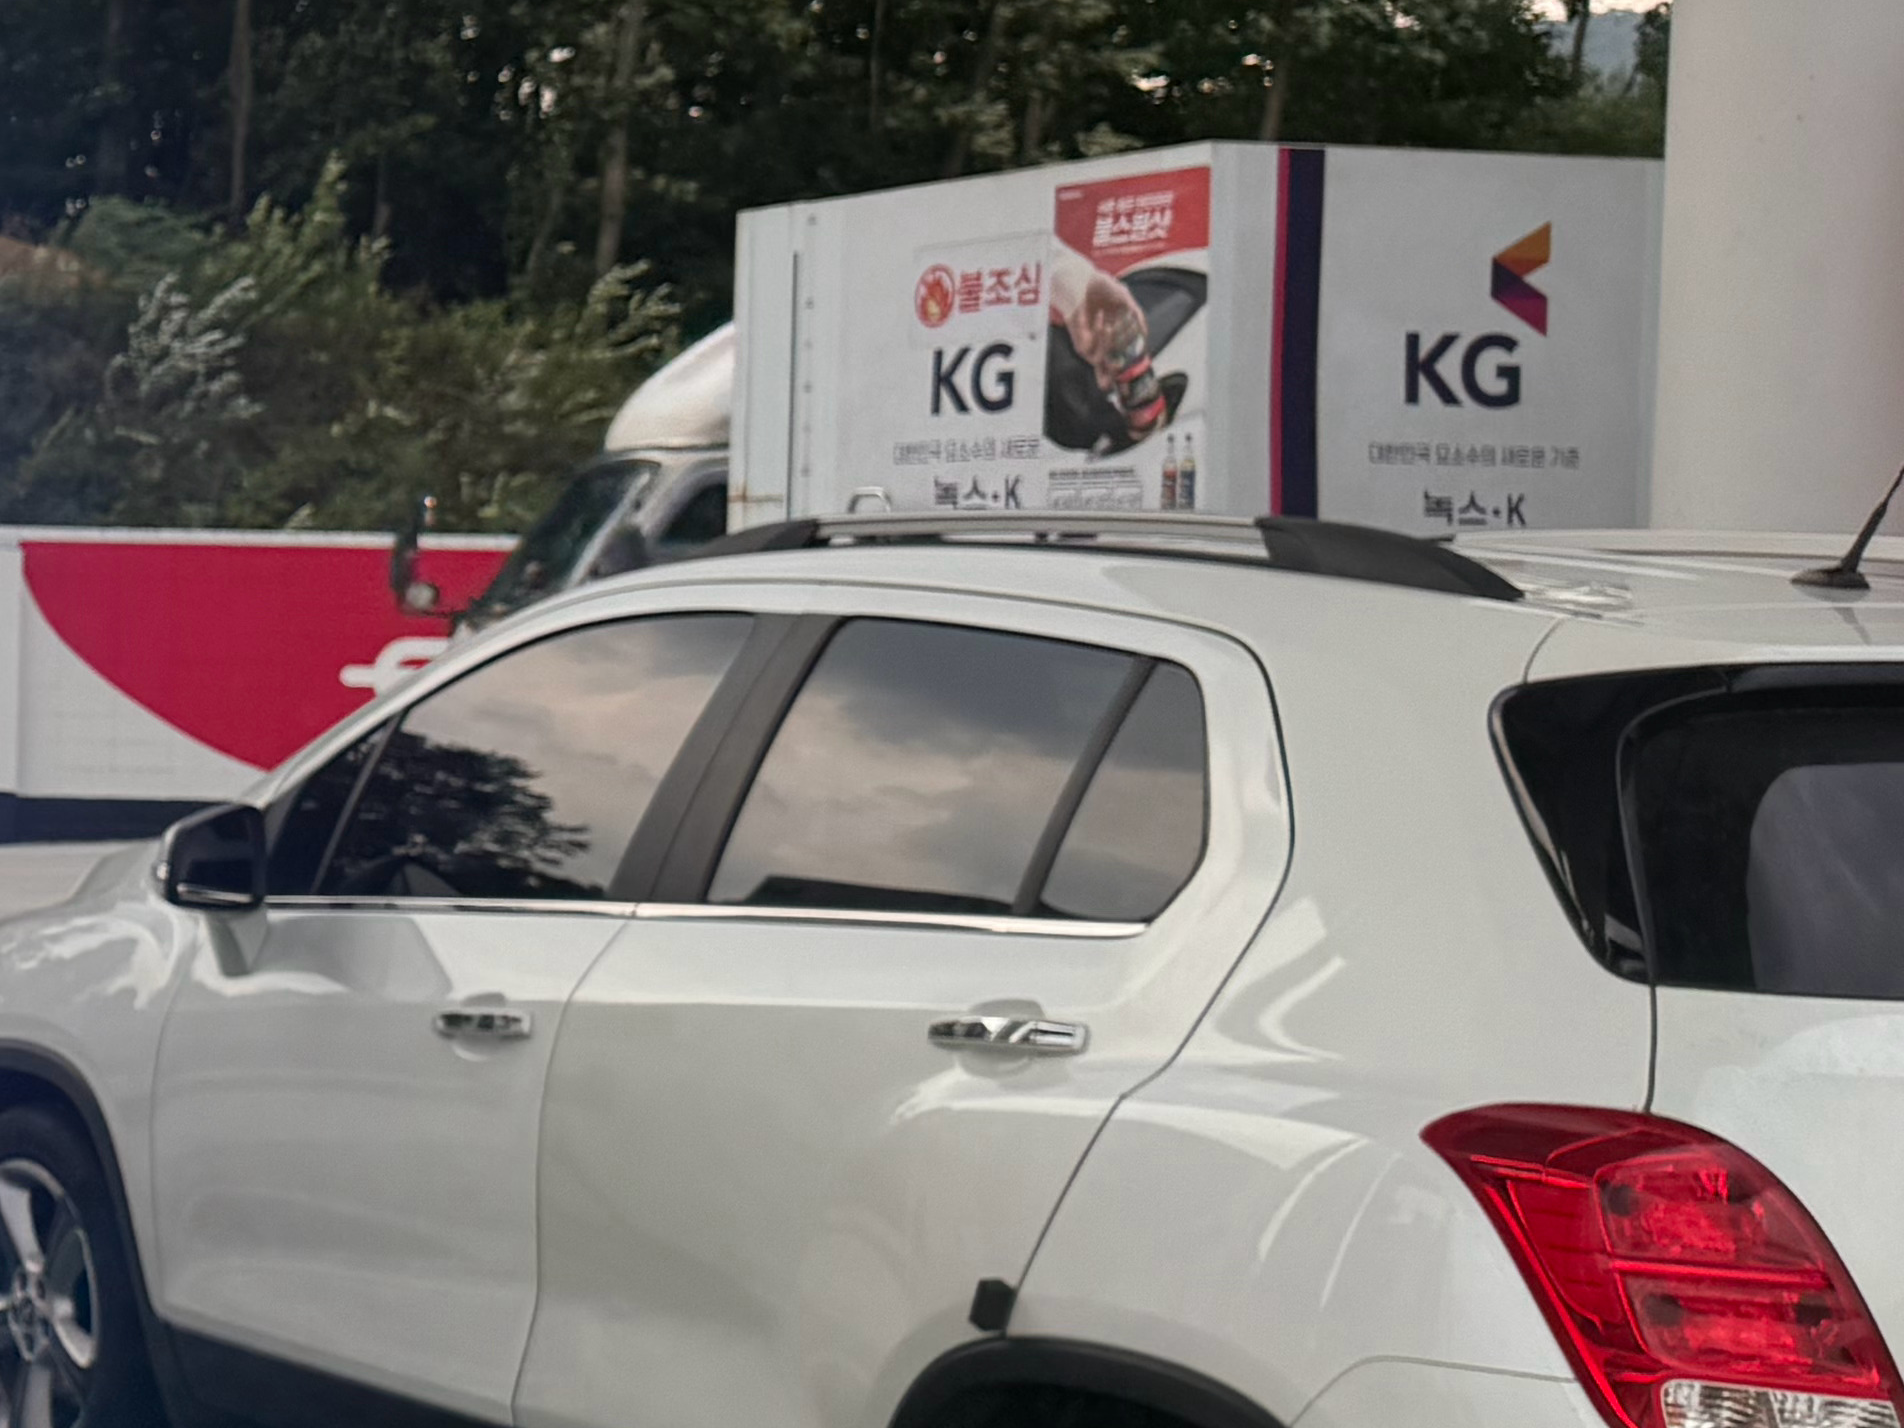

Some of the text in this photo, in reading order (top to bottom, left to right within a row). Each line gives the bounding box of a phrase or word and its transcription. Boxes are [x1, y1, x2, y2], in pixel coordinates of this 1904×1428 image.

[957, 259, 1041, 313] 불조심
[930, 341, 1015, 415] KG
[1404, 330, 1522, 410] KG
